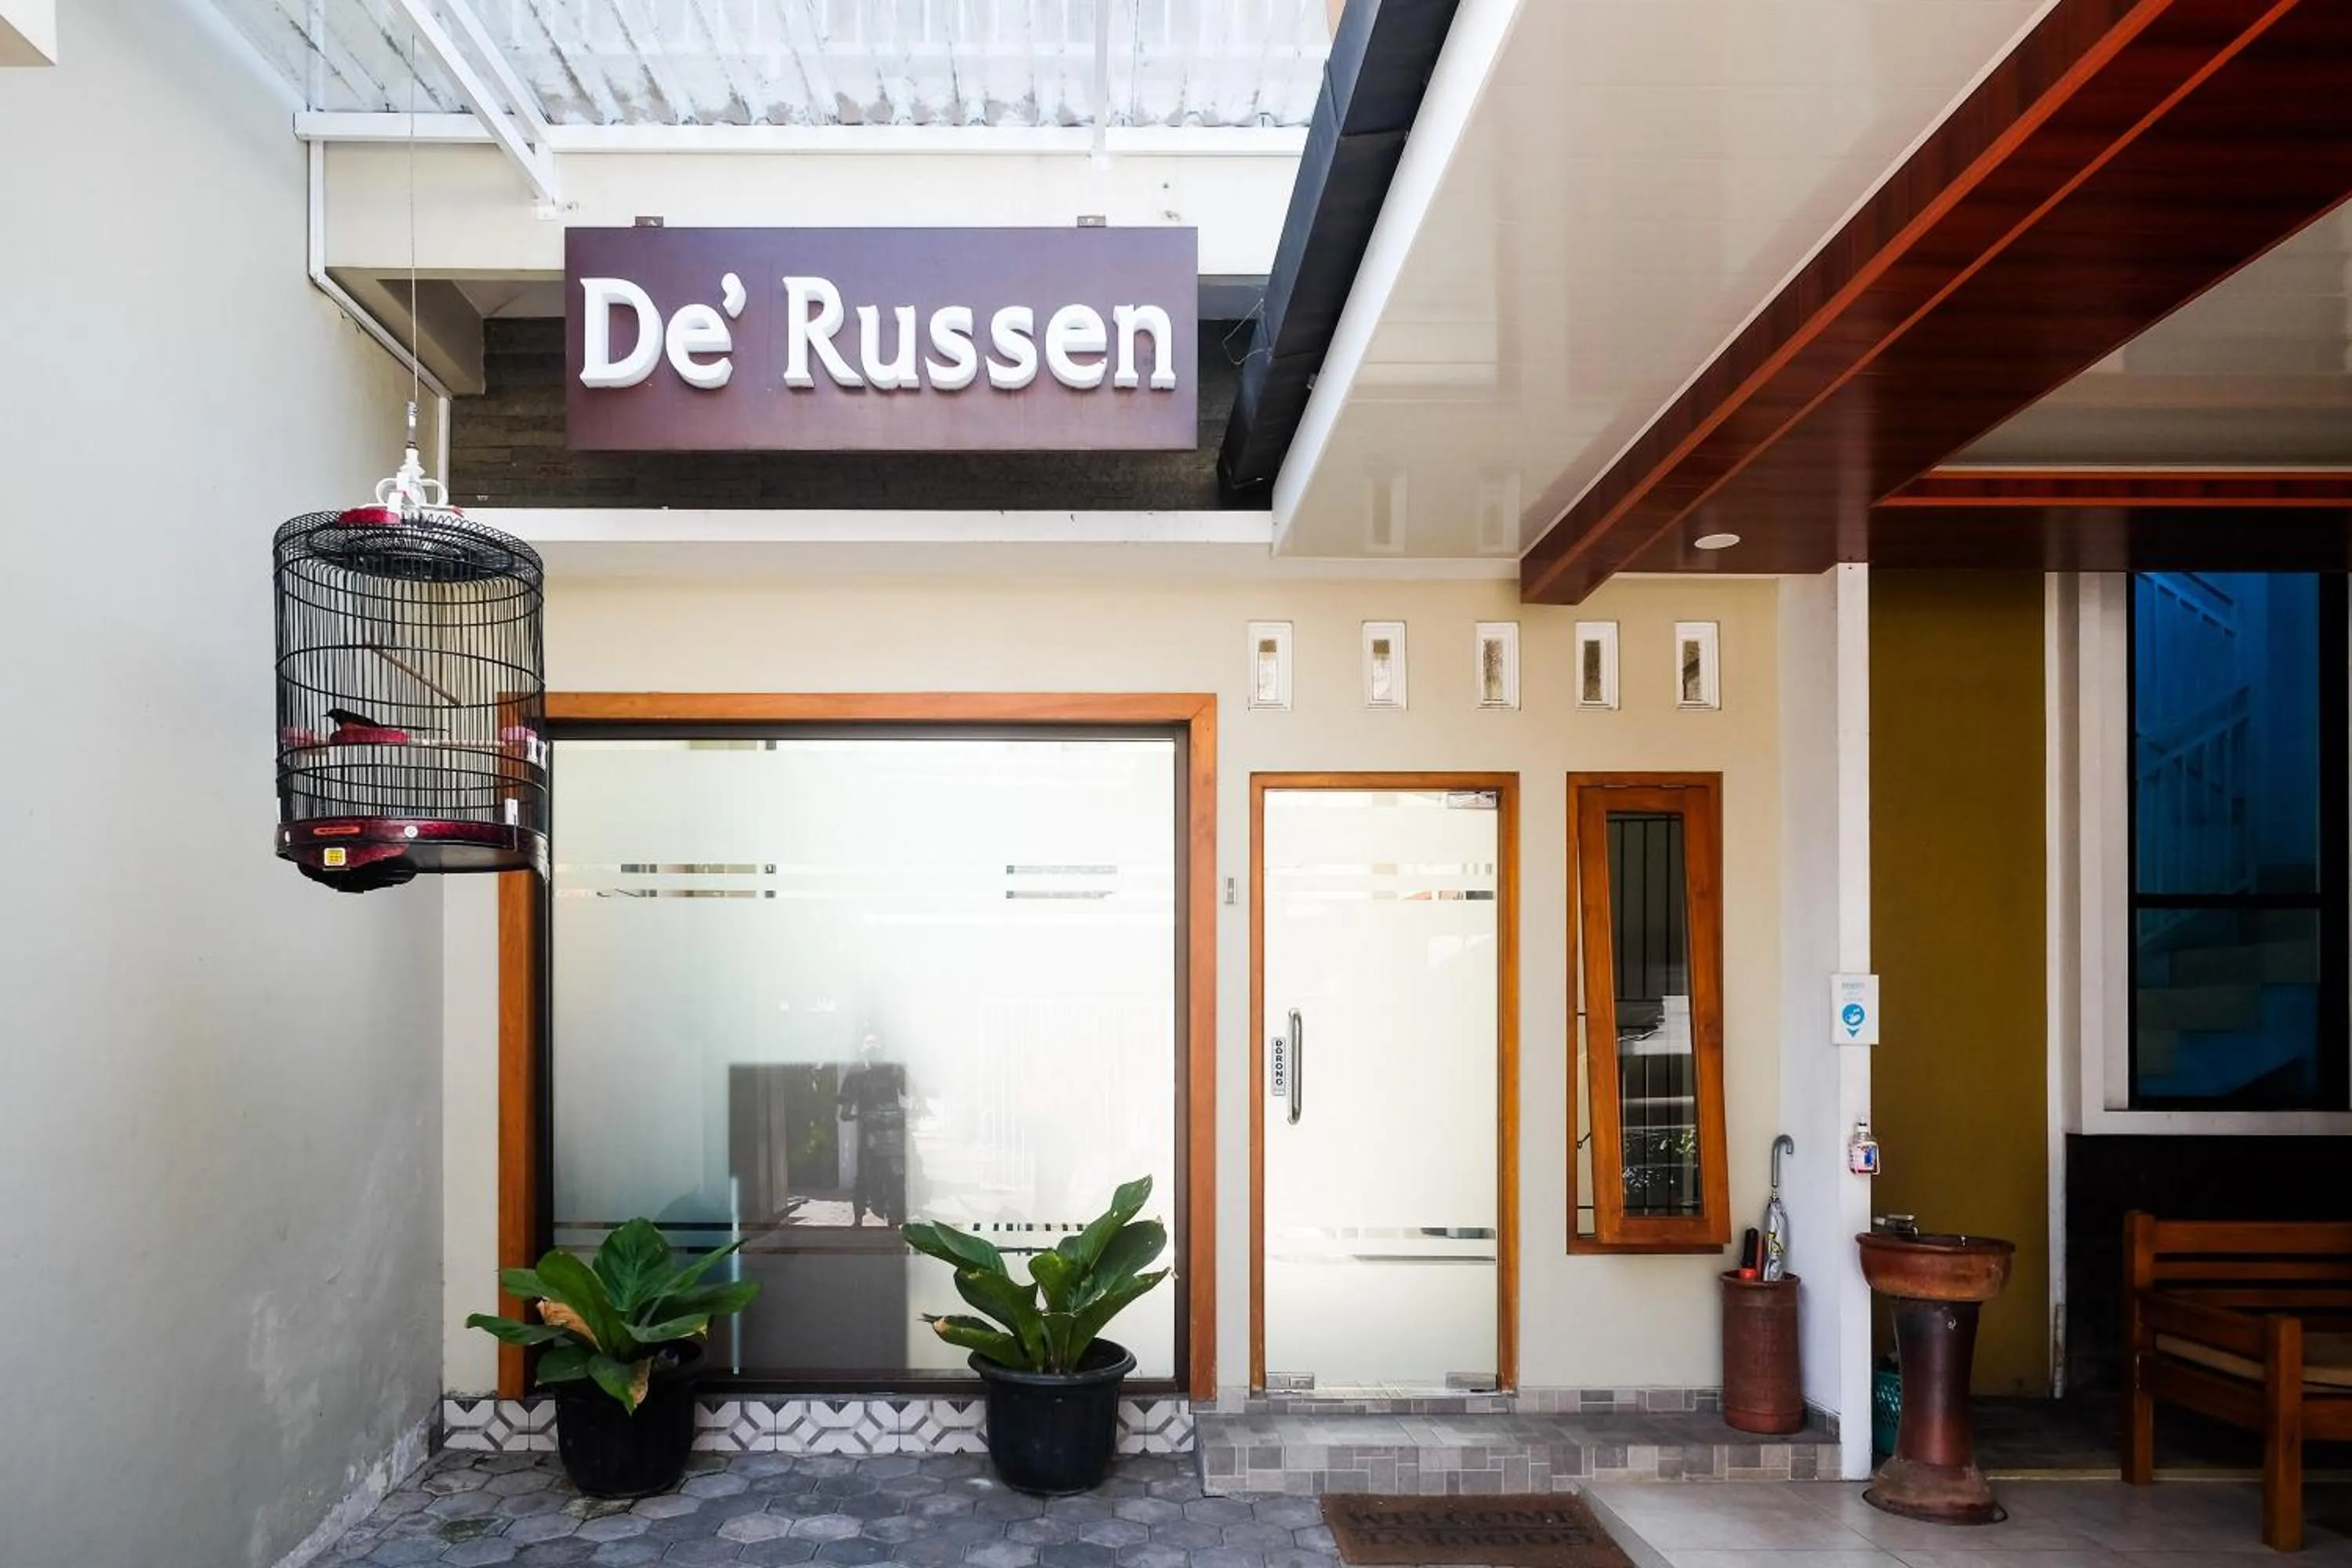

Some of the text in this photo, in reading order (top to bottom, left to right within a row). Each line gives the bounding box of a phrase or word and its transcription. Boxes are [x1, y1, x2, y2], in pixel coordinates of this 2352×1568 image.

[579, 272, 1176, 390] De' Russen
[1275, 1040, 1283, 1086] DORONG
